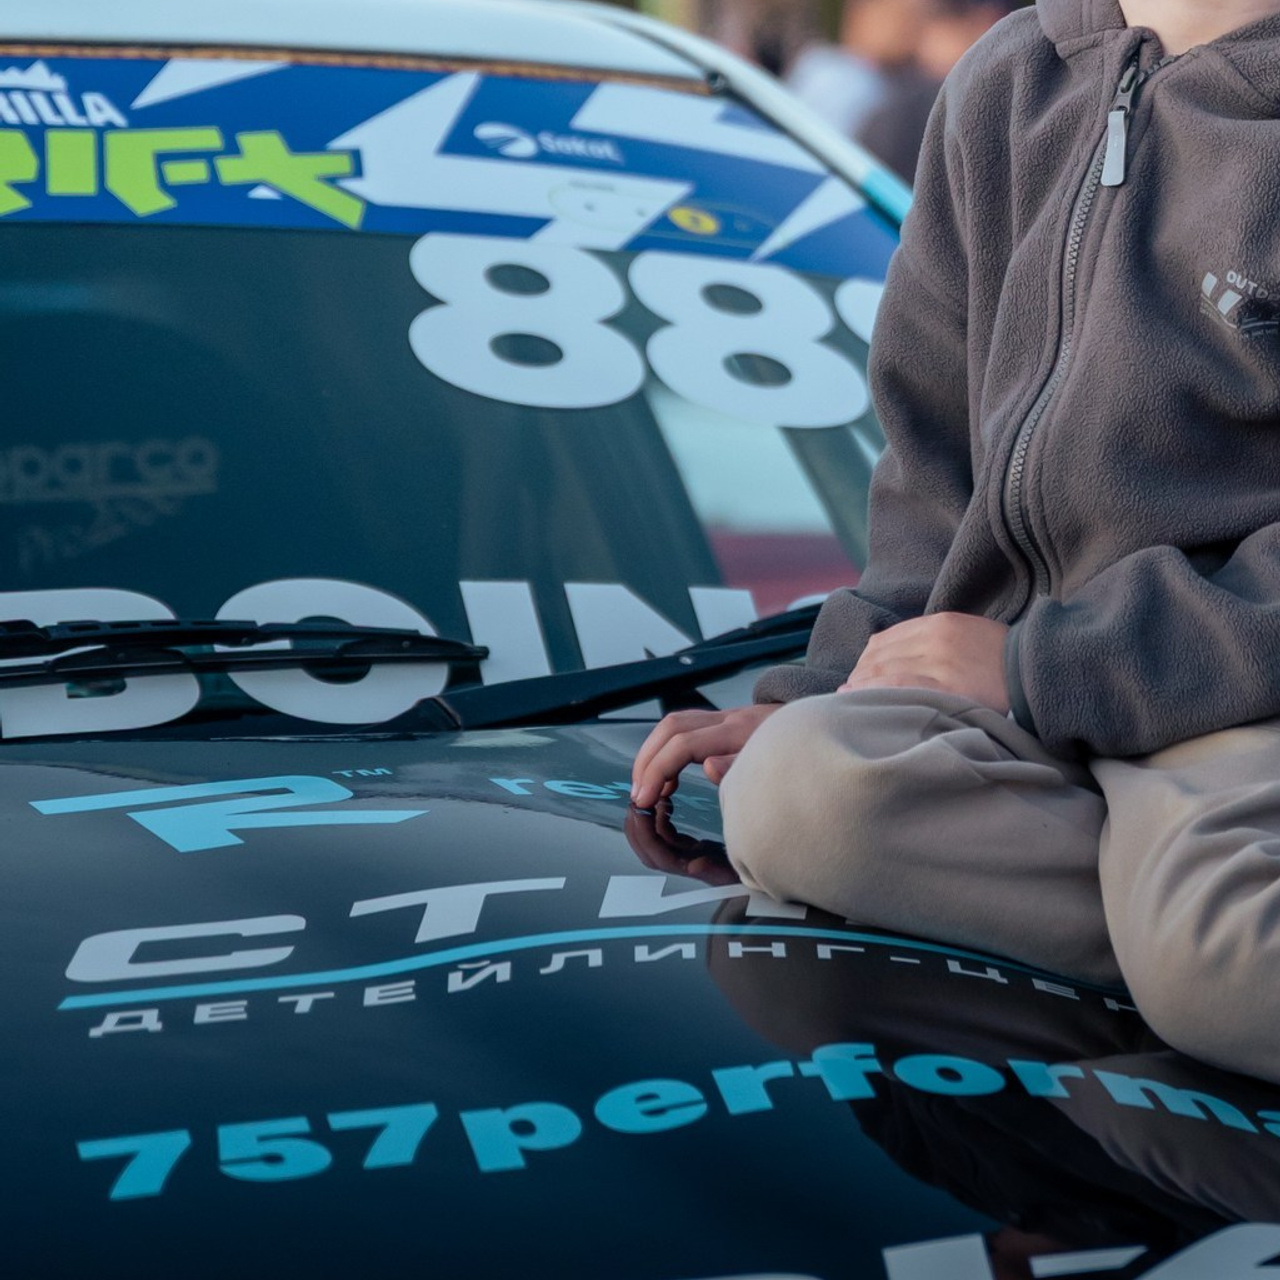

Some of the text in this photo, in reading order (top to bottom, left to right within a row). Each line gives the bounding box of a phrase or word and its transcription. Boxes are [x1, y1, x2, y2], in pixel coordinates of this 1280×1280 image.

[409, 233, 884, 429] 88
[0, 435, 219, 503] parco
[0, 577, 830, 739] BOIN
[65, 875, 860, 982] СТИ
